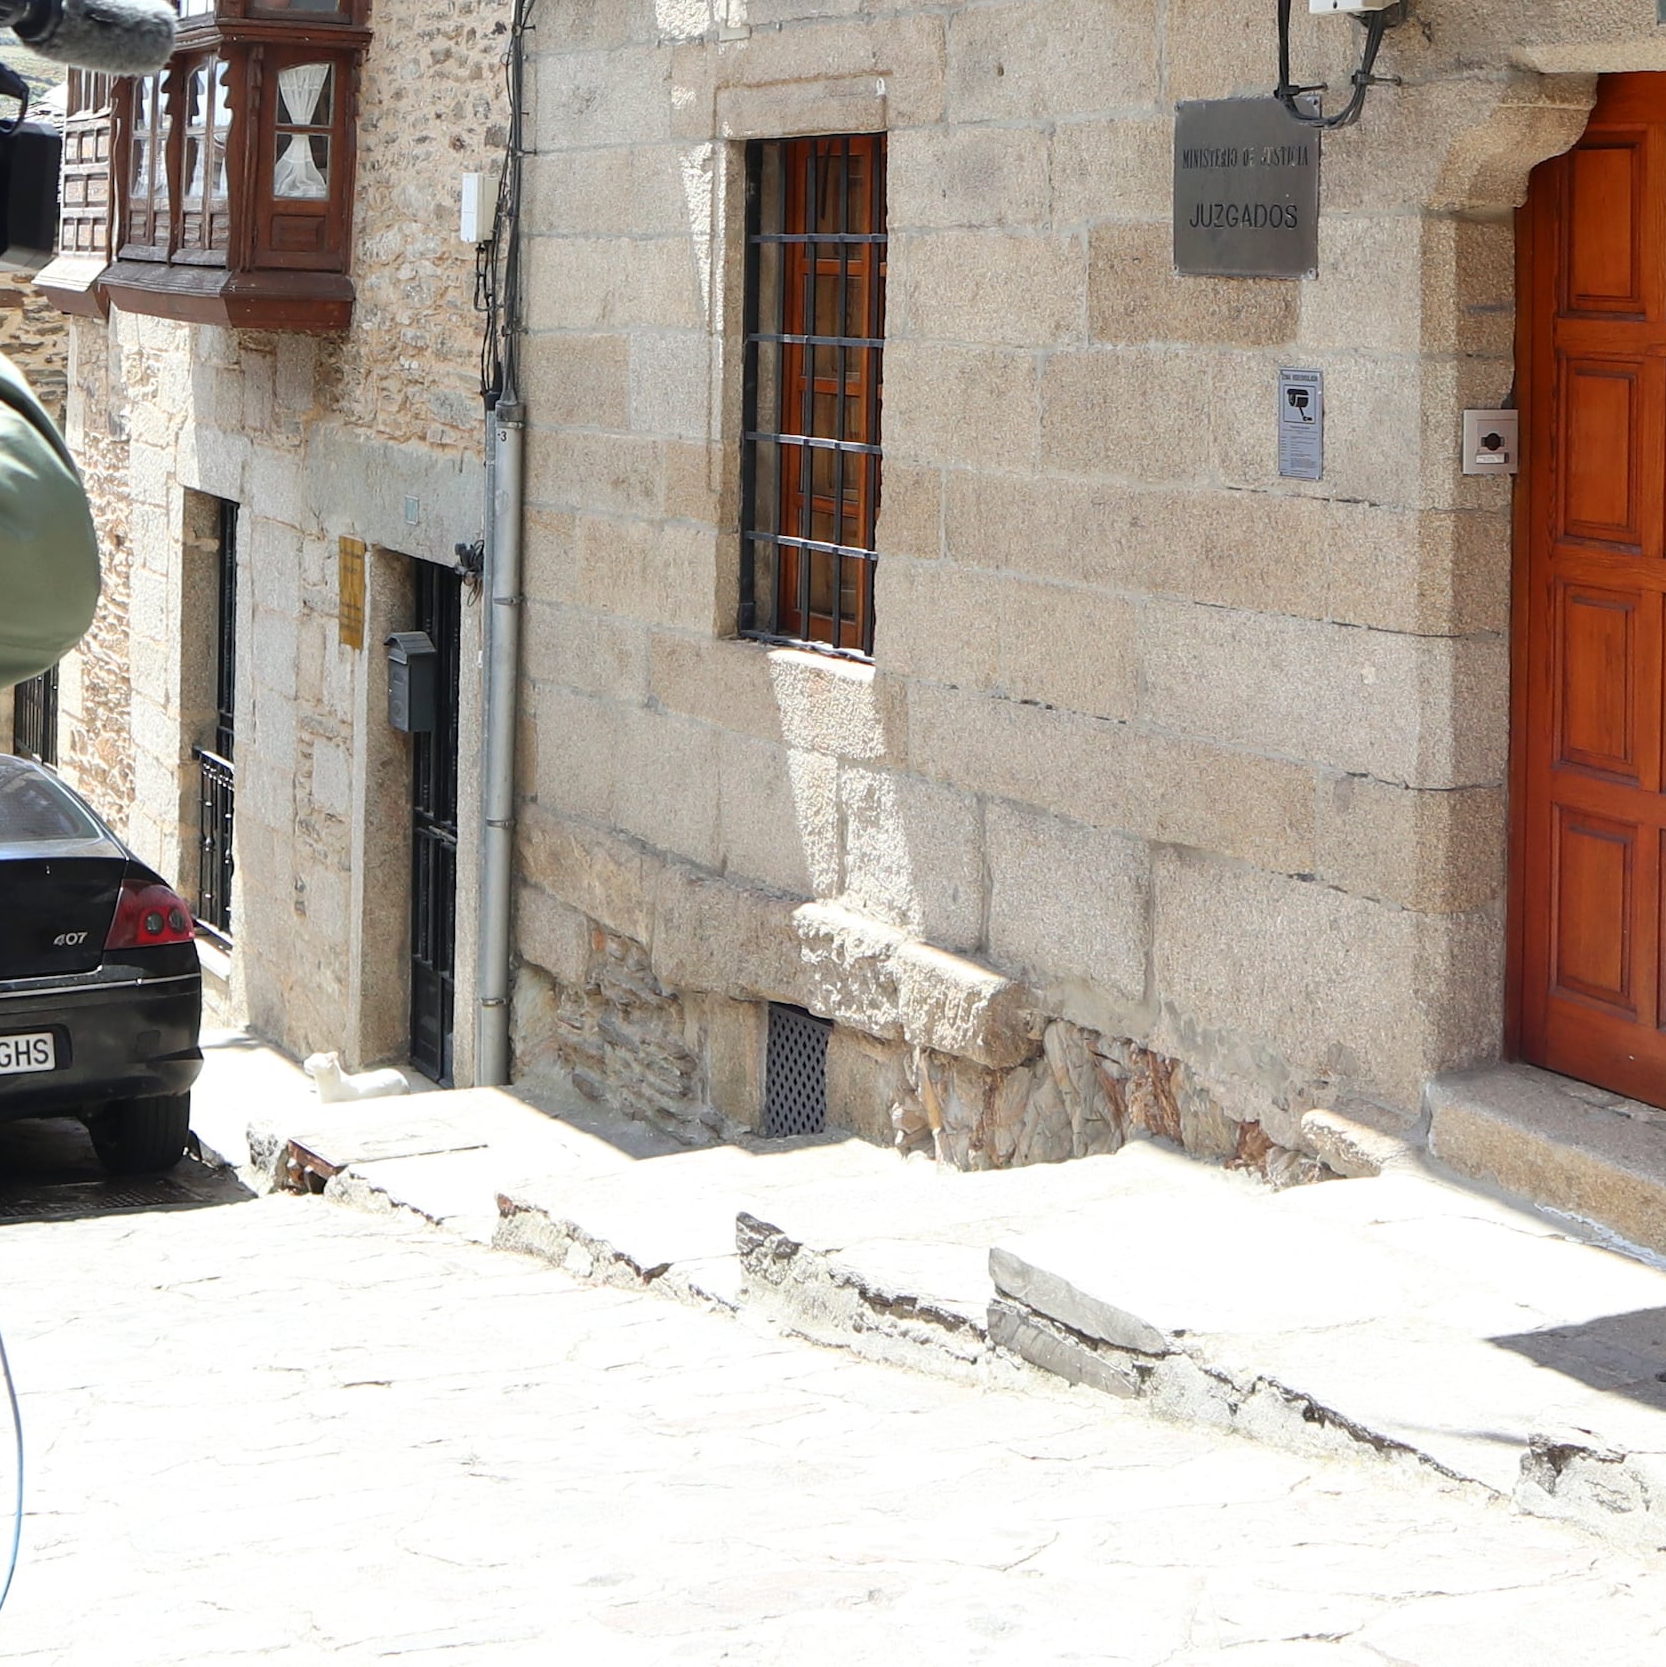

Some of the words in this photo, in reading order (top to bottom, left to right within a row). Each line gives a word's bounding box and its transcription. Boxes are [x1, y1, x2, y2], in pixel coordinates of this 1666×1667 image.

[1182, 146, 1238, 169] MINISTERIO
[1189, 203, 1298, 229] JUZGADOS
[52, 931, 89, 946] 407
